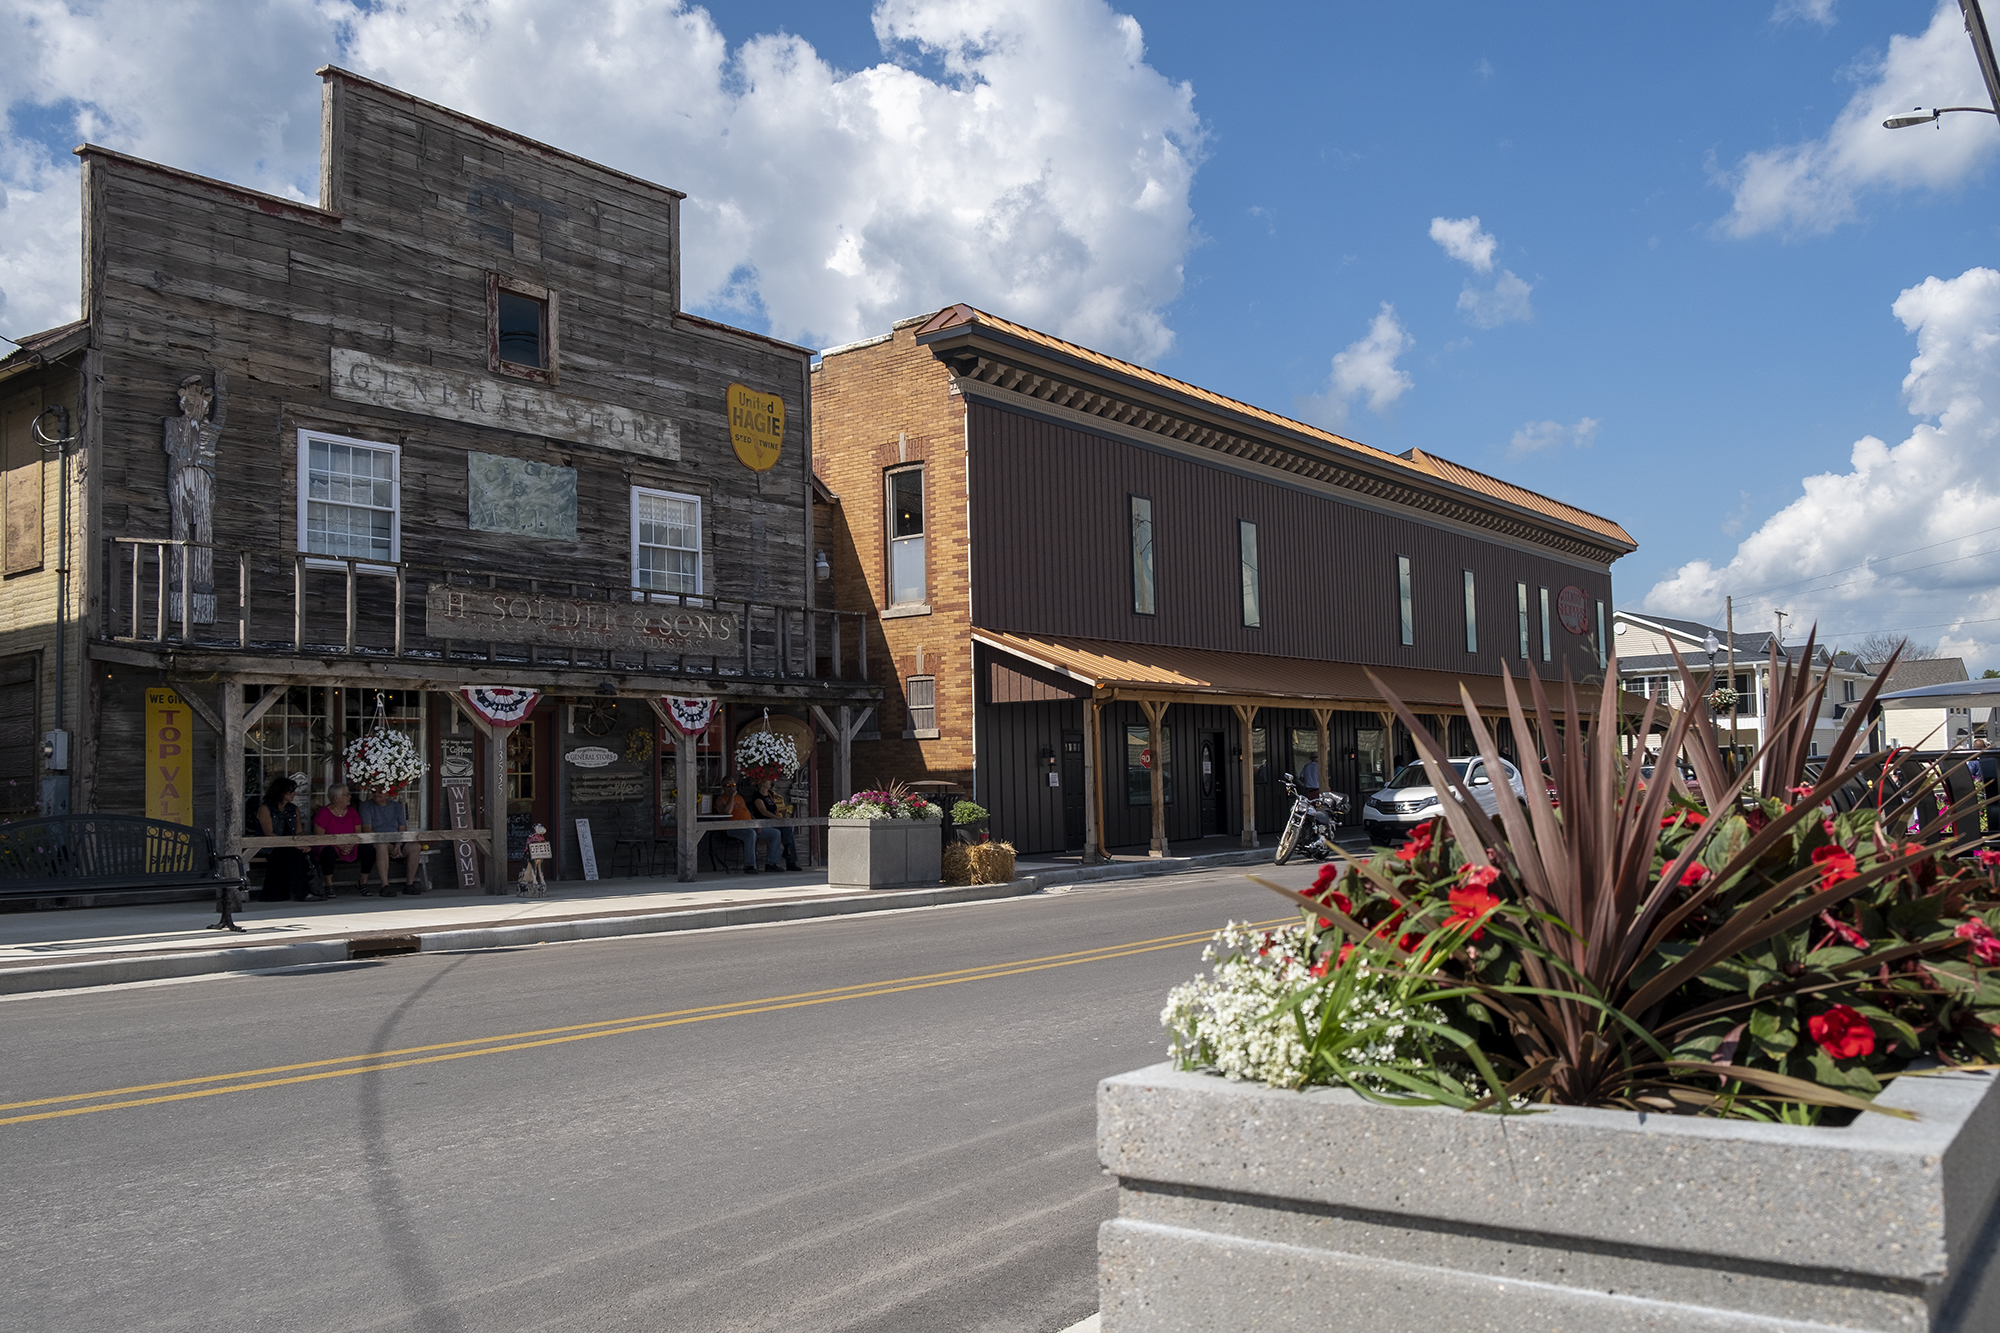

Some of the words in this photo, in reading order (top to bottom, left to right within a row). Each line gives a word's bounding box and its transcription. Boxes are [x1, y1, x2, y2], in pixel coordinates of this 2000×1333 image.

[350, 364, 539, 423] GENERAL
[566, 406, 669, 447] STORE
[739, 392, 774, 414] United
[733, 407, 781, 437] HAGIE
[759, 440, 779, 450] TWINE
[489, 596, 620, 632] SOUDER
[632, 611, 651, 634] &
[658, 612, 732, 641] SONS
[149, 694, 164, 704] WE
[158, 709, 181, 759] TOP
[570, 753, 595, 761] GENERAL
[596, 753, 613, 761] STORE
[60, 800, 67, 810] 4
[531, 844, 550, 853] OPEN
